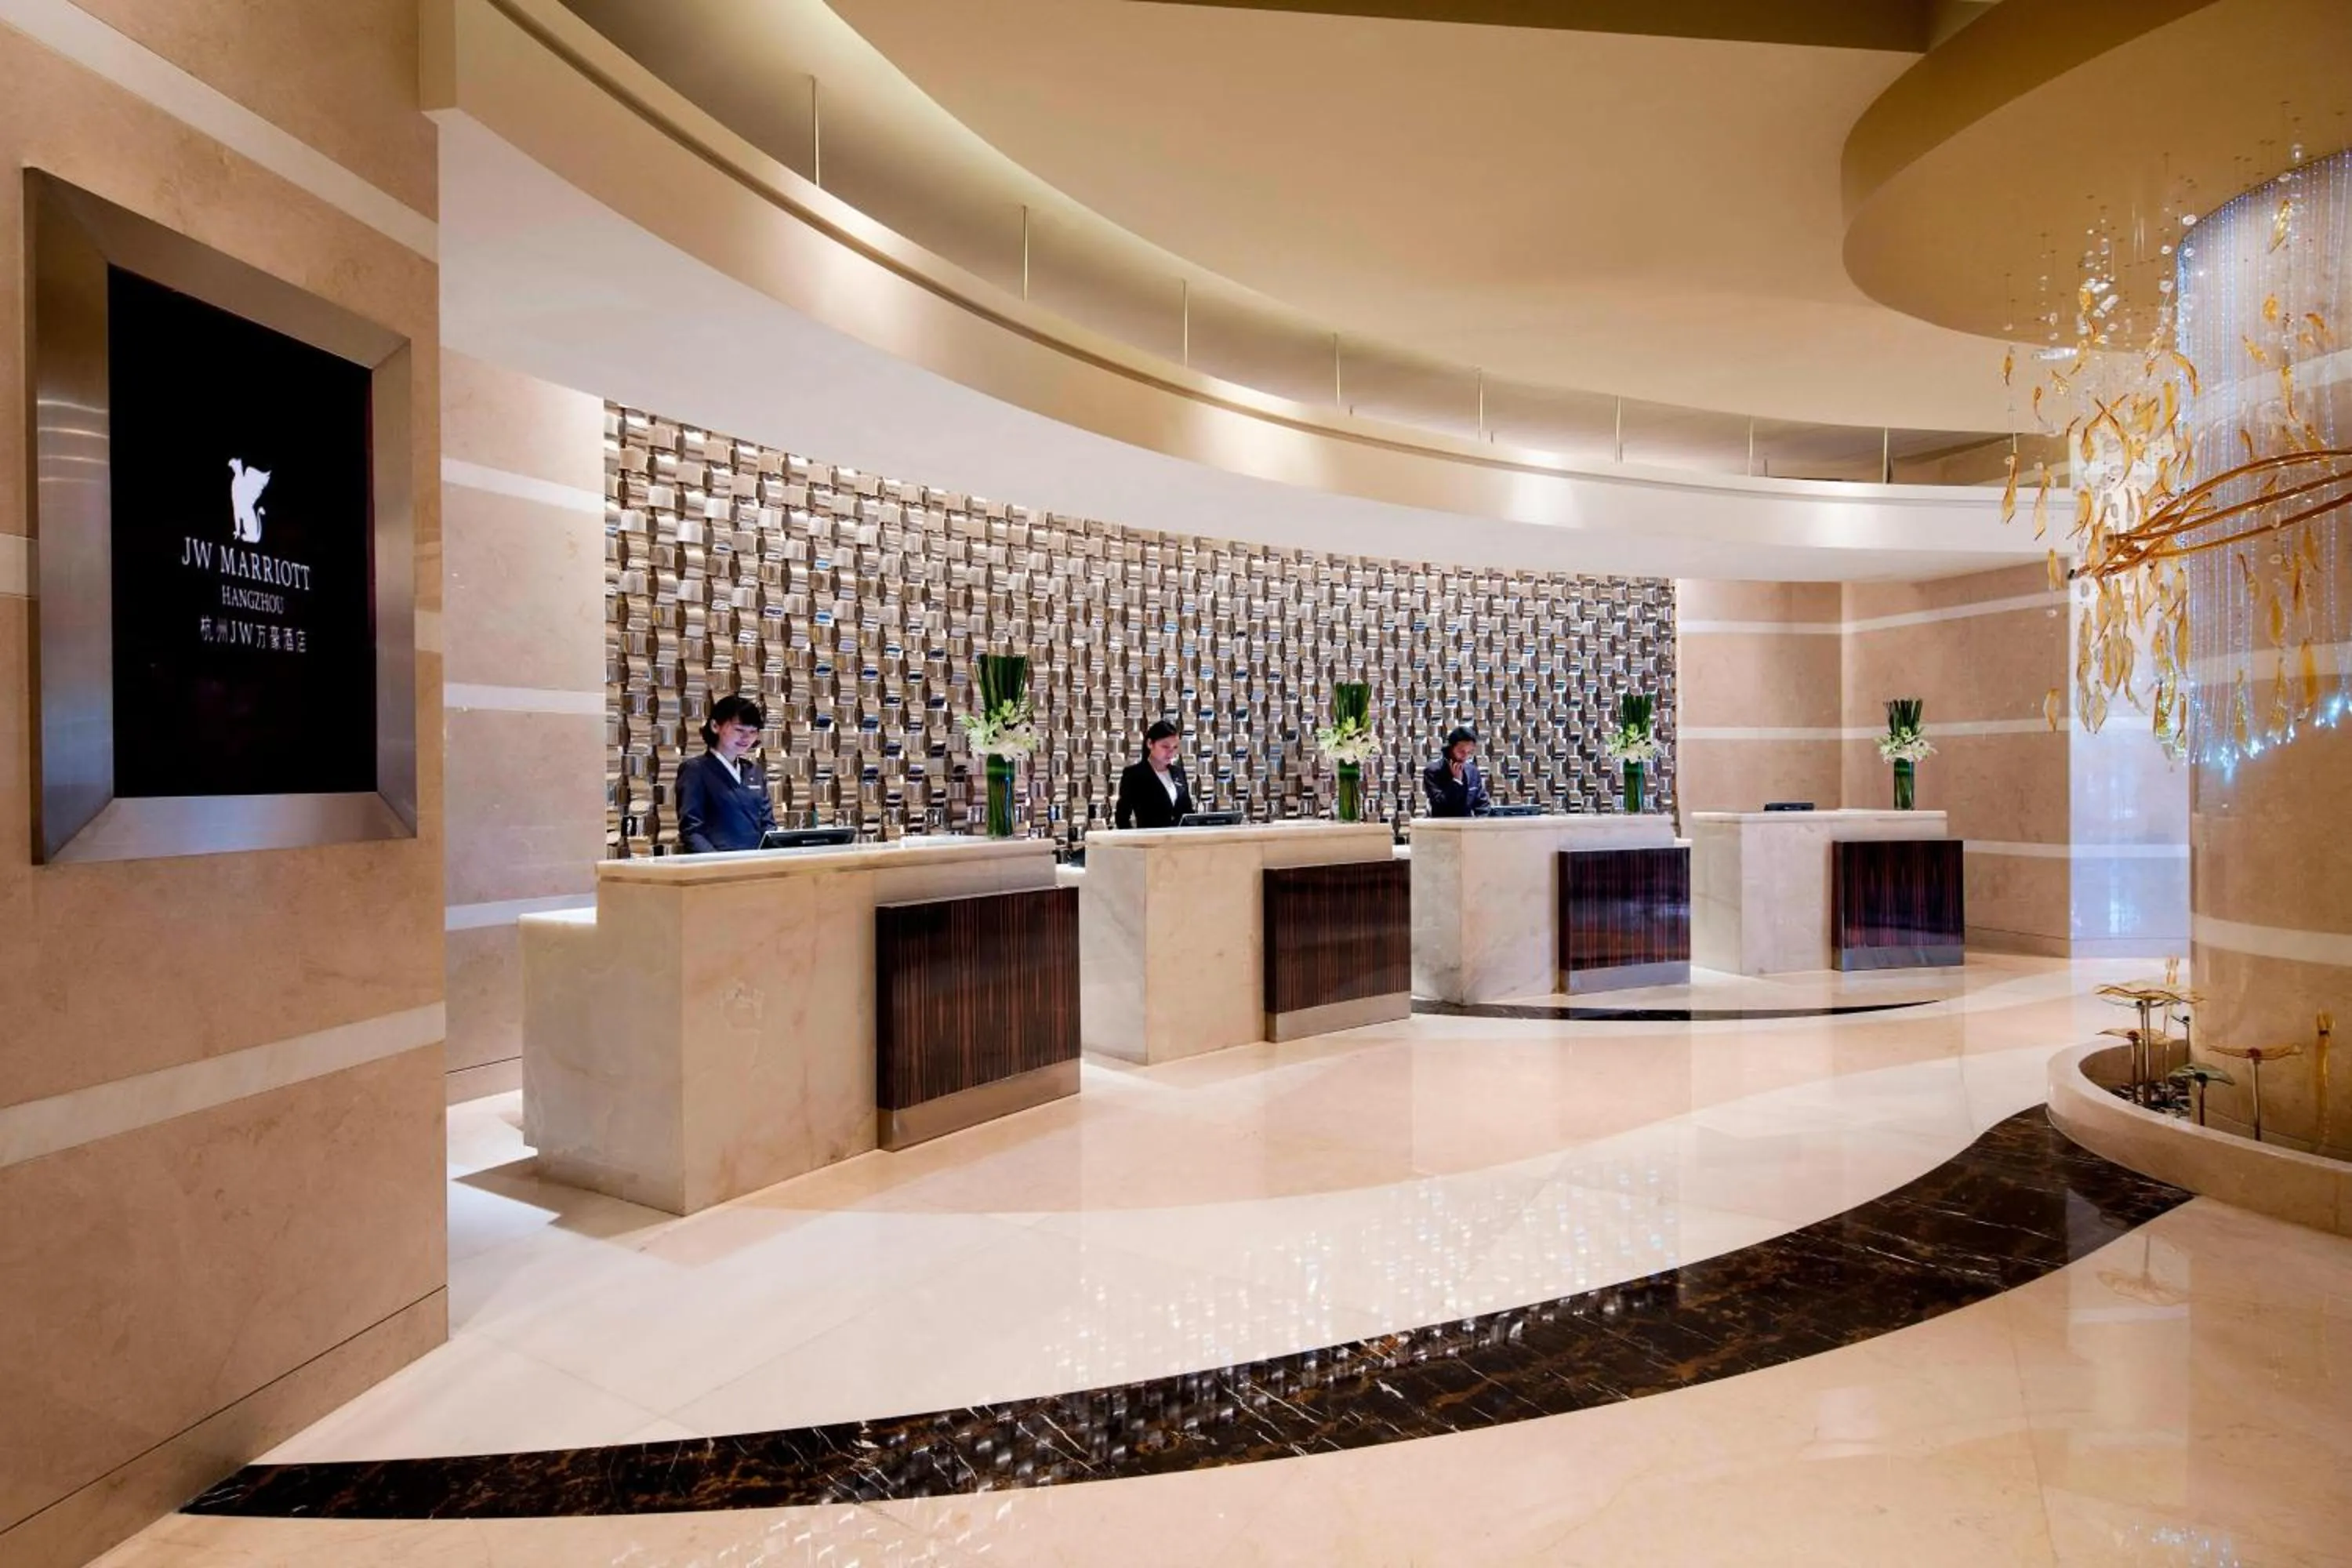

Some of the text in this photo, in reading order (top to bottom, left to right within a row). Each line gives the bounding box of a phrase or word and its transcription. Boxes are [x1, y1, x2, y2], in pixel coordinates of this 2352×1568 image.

[181, 536, 310, 590] JW MARRIOTT
[222, 585, 284, 614] HANGZHOU
